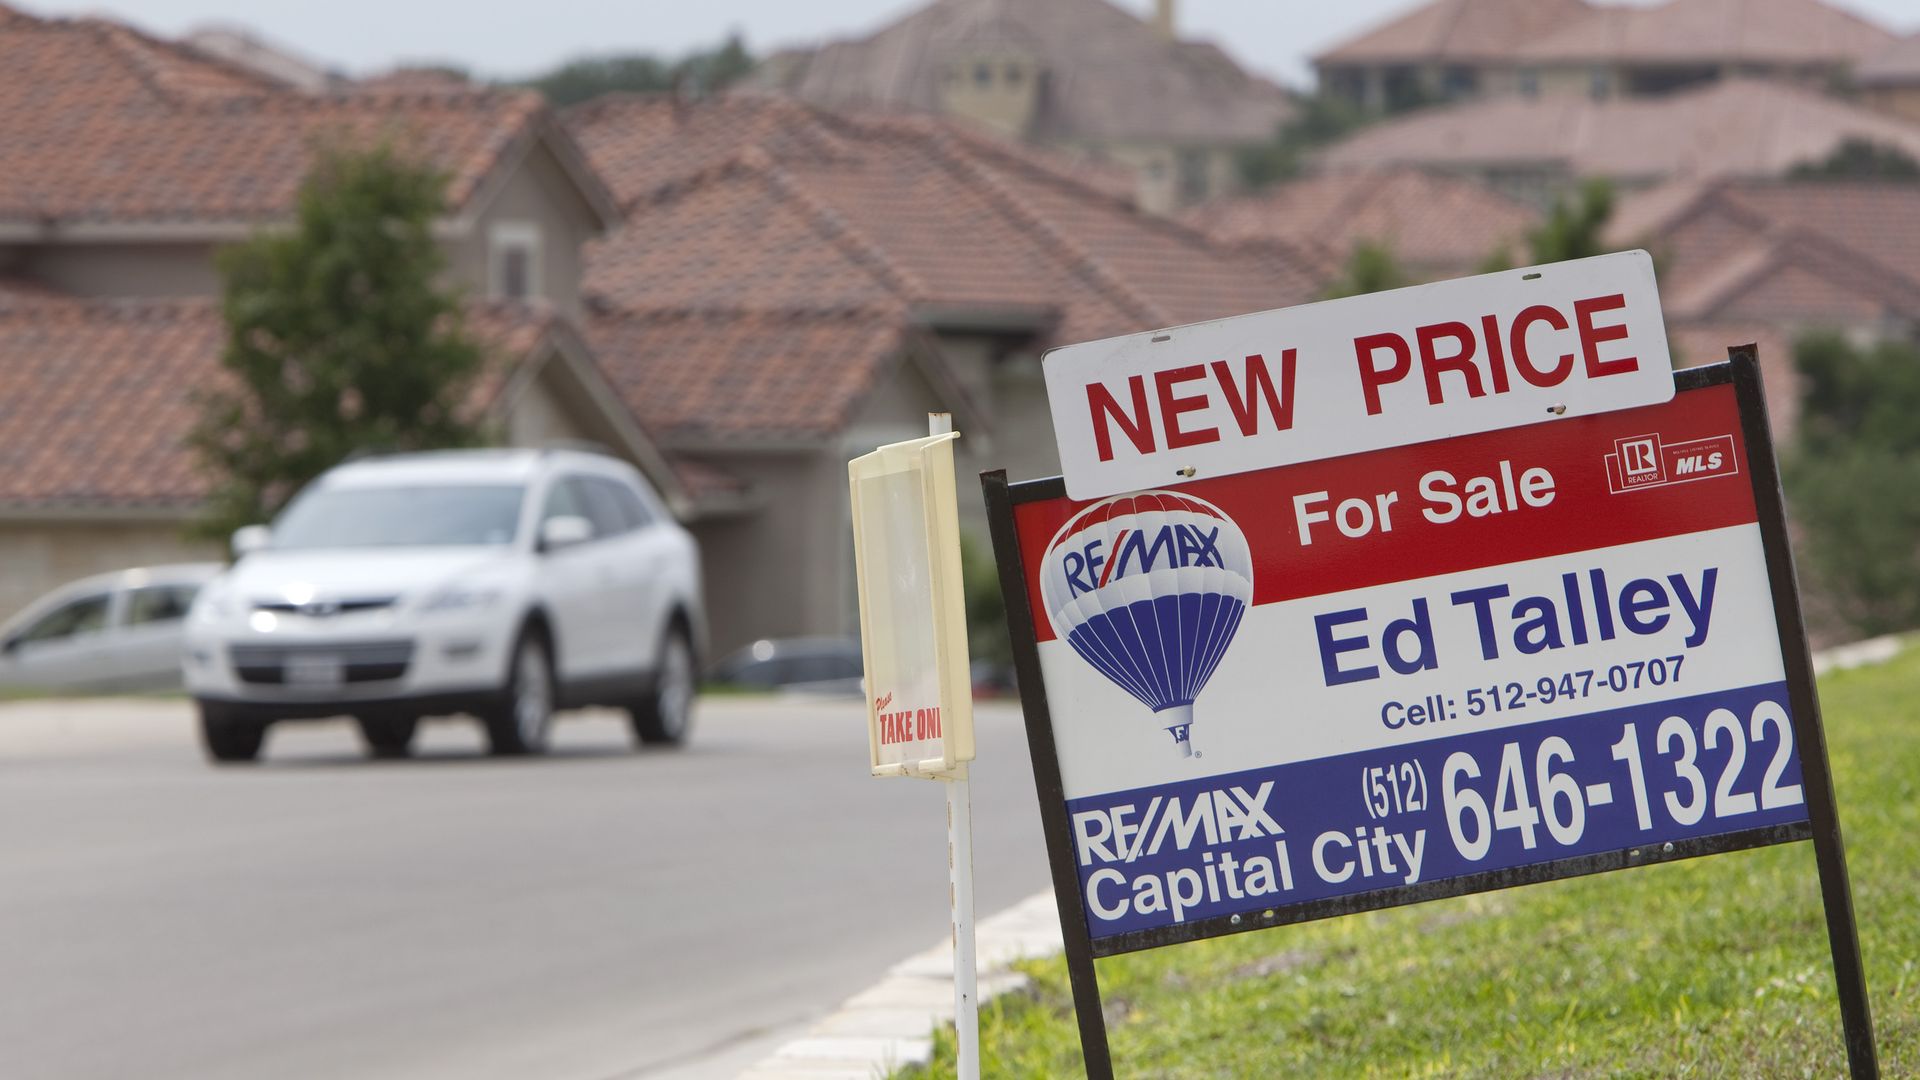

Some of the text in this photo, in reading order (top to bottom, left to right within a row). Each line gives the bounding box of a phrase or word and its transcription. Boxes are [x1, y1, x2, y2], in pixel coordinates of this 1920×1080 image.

[1086, 294, 1639, 462] NEW PRICE
[1293, 460, 1556, 546] For Sale
[1627, 472, 1659, 484] REALTOR
[1676, 451, 1723, 475] MLS
[1063, 523, 1225, 600] RE/MAX
[1314, 567, 1718, 685] Ed Talley
[880, 710, 913, 745] TAKE
[1381, 654, 1686, 730] Cell: 512-947-0707
[1072, 780, 1286, 867] RE/MAX
[1362, 700, 1805, 861] (512) 646-1322
[1086, 826, 1427, 923] Capital City
